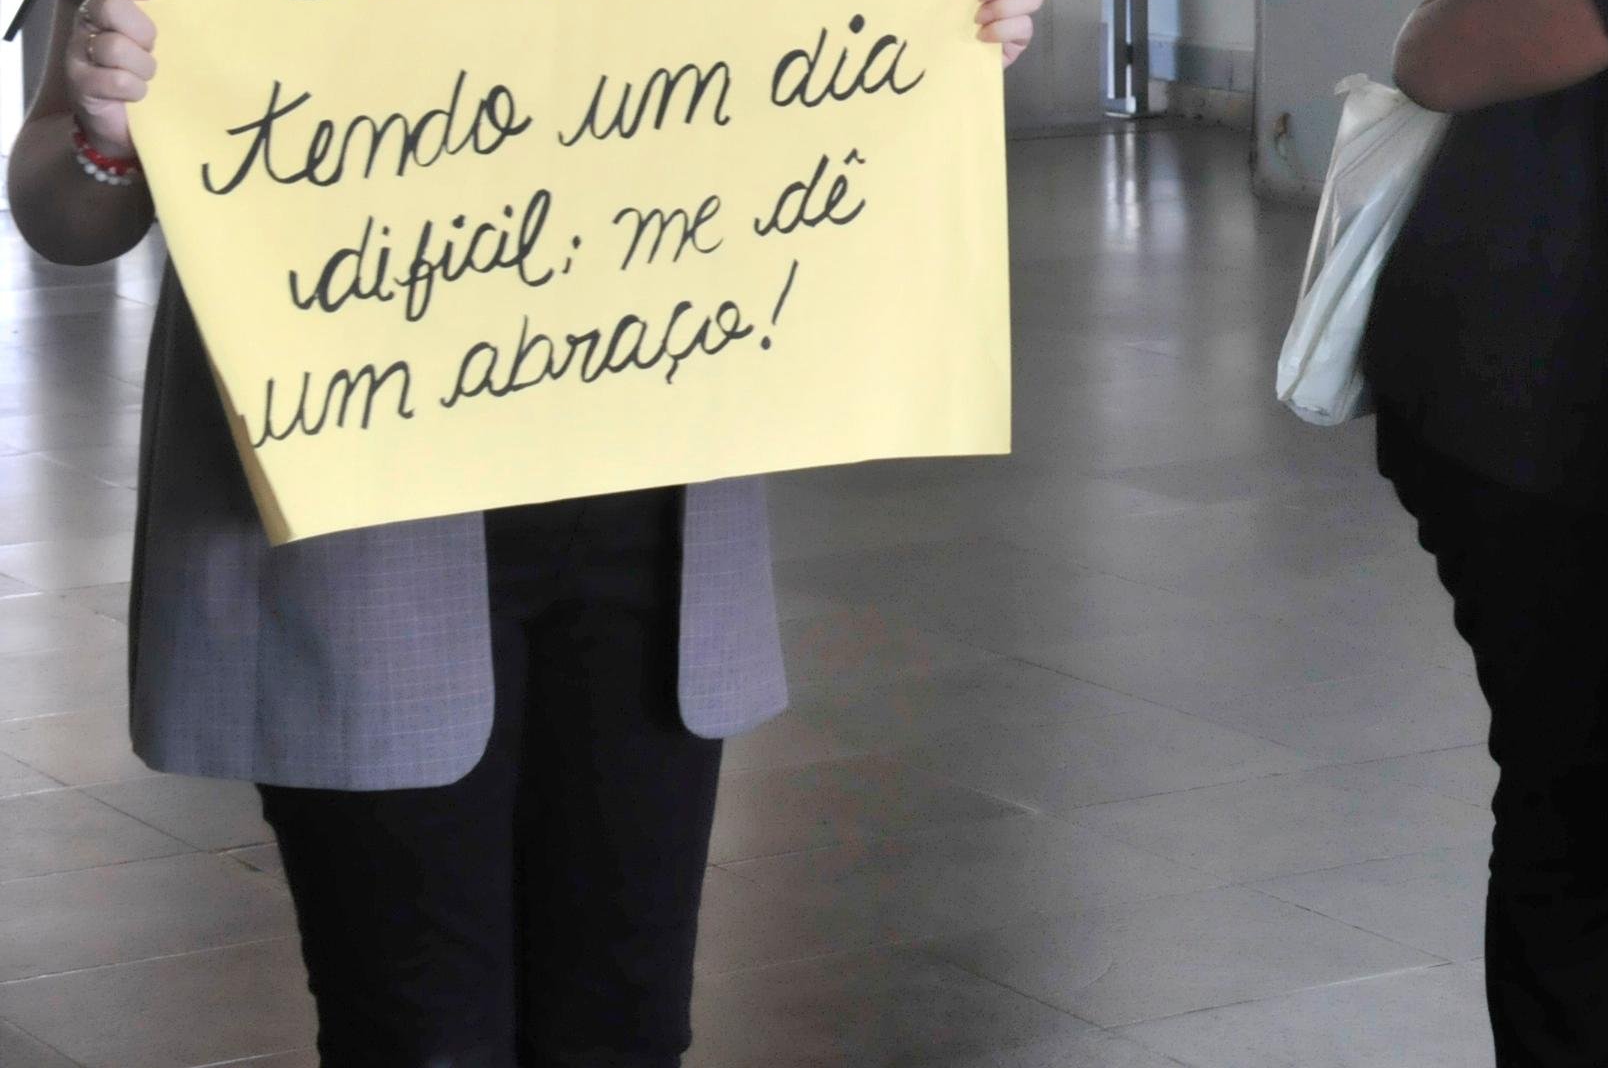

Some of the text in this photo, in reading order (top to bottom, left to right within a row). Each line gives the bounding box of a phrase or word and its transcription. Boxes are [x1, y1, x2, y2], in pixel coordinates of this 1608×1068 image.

[201, 13, 925, 196] tendo um dia
[612, 194, 722, 271] me
[753, 148, 866, 237] dê
[253, 259, 799, 450] um abraço!
